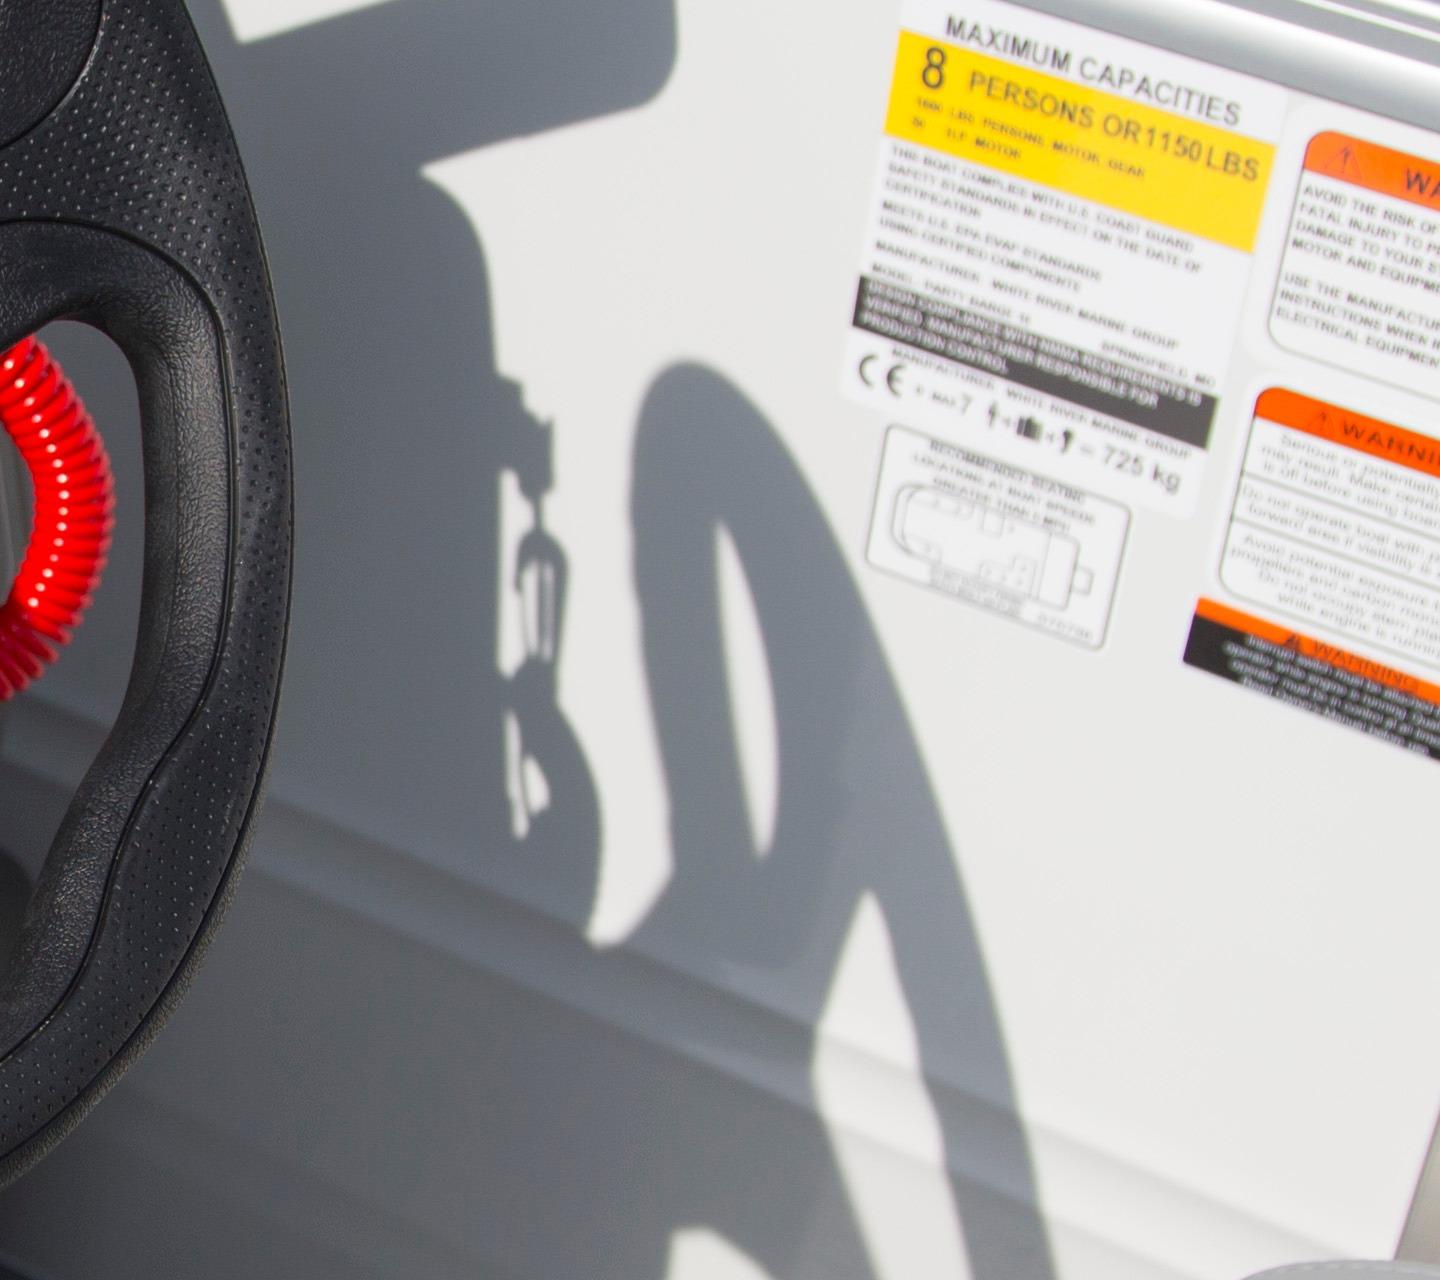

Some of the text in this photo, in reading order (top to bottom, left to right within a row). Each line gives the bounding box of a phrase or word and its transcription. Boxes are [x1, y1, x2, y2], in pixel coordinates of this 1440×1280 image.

[919, 43, 948, 92] 8
[967, 70, 1097, 130] PERSONS
[1100, 113, 1146, 147] OR
[1144, 127, 1203, 164] 1150
[1204, 145, 1262, 182] LBS
[943, 14, 1244, 128] MAXIMUM CAPACITIES
[1099, 443, 1146, 478] 725
[1149, 460, 1184, 496] kg
[1311, 640, 1421, 694] WARNING
